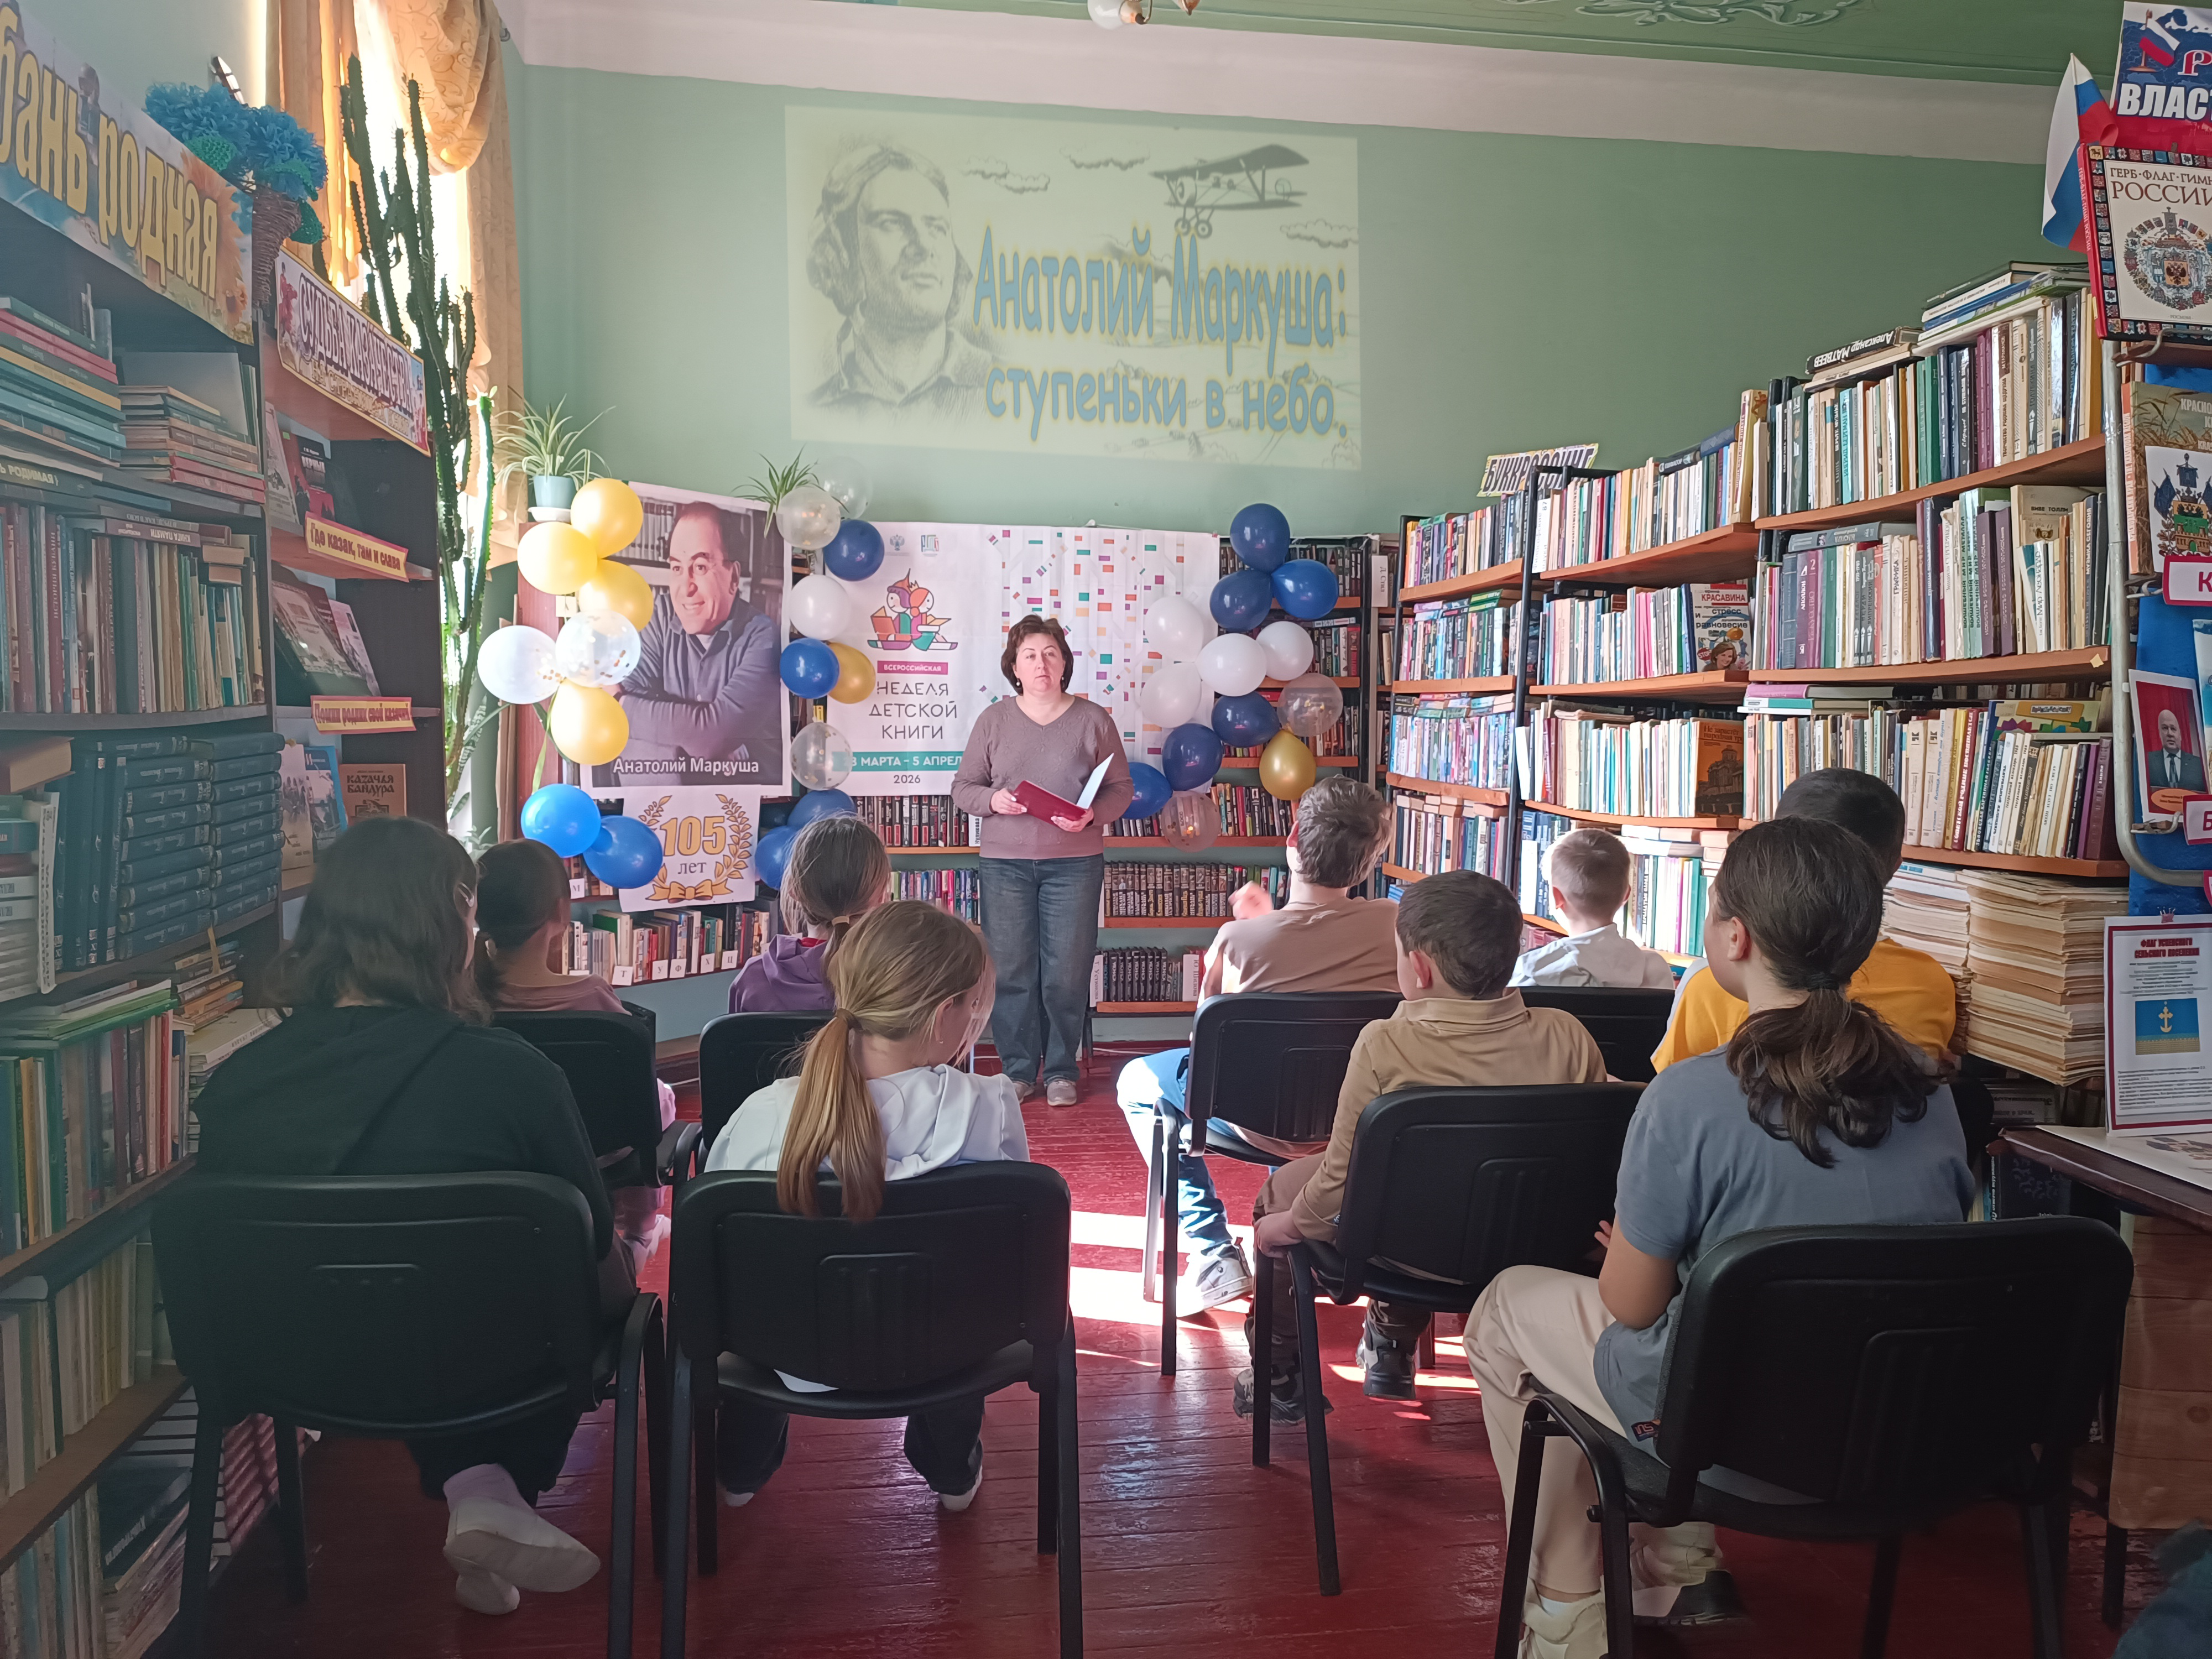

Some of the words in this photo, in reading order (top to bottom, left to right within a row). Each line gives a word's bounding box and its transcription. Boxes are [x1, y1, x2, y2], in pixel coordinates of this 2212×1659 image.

[2117, 83, 2212, 121] ВЛАС
[0, 5, 87, 215] бань
[97, 111, 218, 301] родная
[972, 223, 1155, 341] Анатолий
[1170, 232, 1347, 378] Маркуша:
[1851, 331, 1893, 353] Александр
[1814, 345, 1850, 368] МАТВЕЕВ
[985, 366, 1187, 442] ступеньки
[1206, 380, 1225, 430] в
[1241, 364, 1349, 440] небо.
[2180, 398, 2212, 415] КРАСНО
[1542, 501, 1547, 511] 87
[311, 523, 325, 546] Где
[327, 533, 356, 560] казак,
[357, 544, 372, 564] там
[380, 551, 400, 571] слава
[1533, 512, 1542, 571] Философские
[2036, 596, 2044, 615] Мир
[877, 681, 948, 696] НЕДЕЛЯ
[868, 701, 957, 718] ДЕТСКОЙ
[882, 724, 943, 739] КНИГИ
[1703, 733, 1733, 741] народная
[1963, 712, 1973, 768] ПОСВЯЩАЕТСЯ
[613, 757, 686, 773] Анатолий
[690, 758, 759, 775] Маркуша
[861, 757, 901, 766] МАРТА
[913, 757, 919, 766] 5
[923, 756, 962, 766] АПРЕЛ
[893, 775, 921, 784] 2026
[1959, 768, 1968, 800] РОДИНЕ
[1998, 765, 2006, 802] ТЕАТРАЛЬНЫЙ
[2024, 766, 2033, 800] ЧАЙКОВСКИЙ
[2049, 783, 2054, 791] ПО
[347, 784, 394, 798] БАНДУРА
[1975, 811, 1984, 846] ЛЬВОВСКАЯ
[1980, 775, 1989, 810] КАРТИННАЯ
[1954, 801, 1964, 843] СОВЕТСКОЙ
[660, 815, 726, 857] 105
[678, 862, 707, 875] лет
